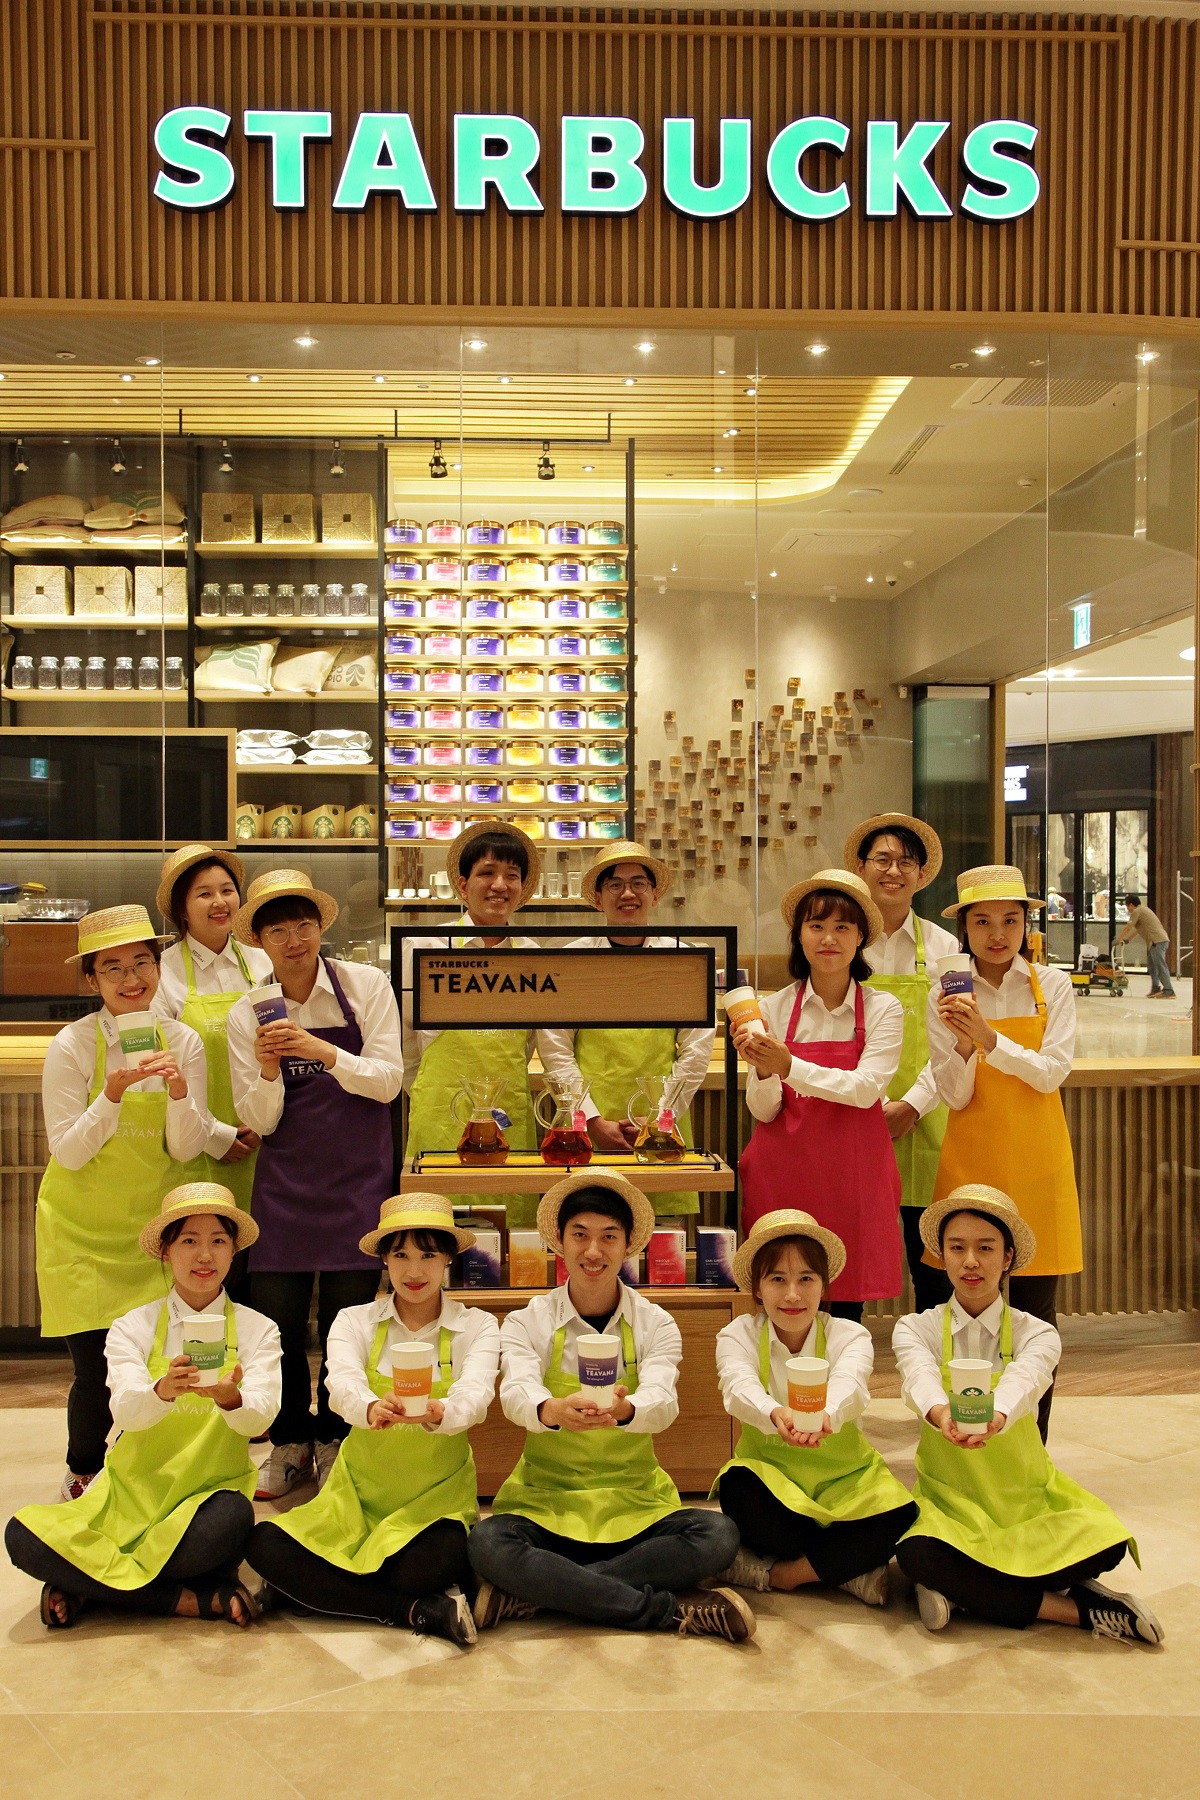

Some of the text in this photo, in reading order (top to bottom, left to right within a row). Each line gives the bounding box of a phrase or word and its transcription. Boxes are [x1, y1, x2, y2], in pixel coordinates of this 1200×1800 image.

[152, 105, 1041, 222] STARBUCKS
[429, 960, 489, 968] STARBUCKS
[429, 973, 557, 993] TEAVANA
[126, 1037, 150, 1045] TEAVANA
[289, 1064, 323, 1076] TEAV
[115, 1128, 163, 1138] EAVANA
[191, 1354, 219, 1362] TEAVANA
[958, 1407, 987, 1415] TEAVANA
